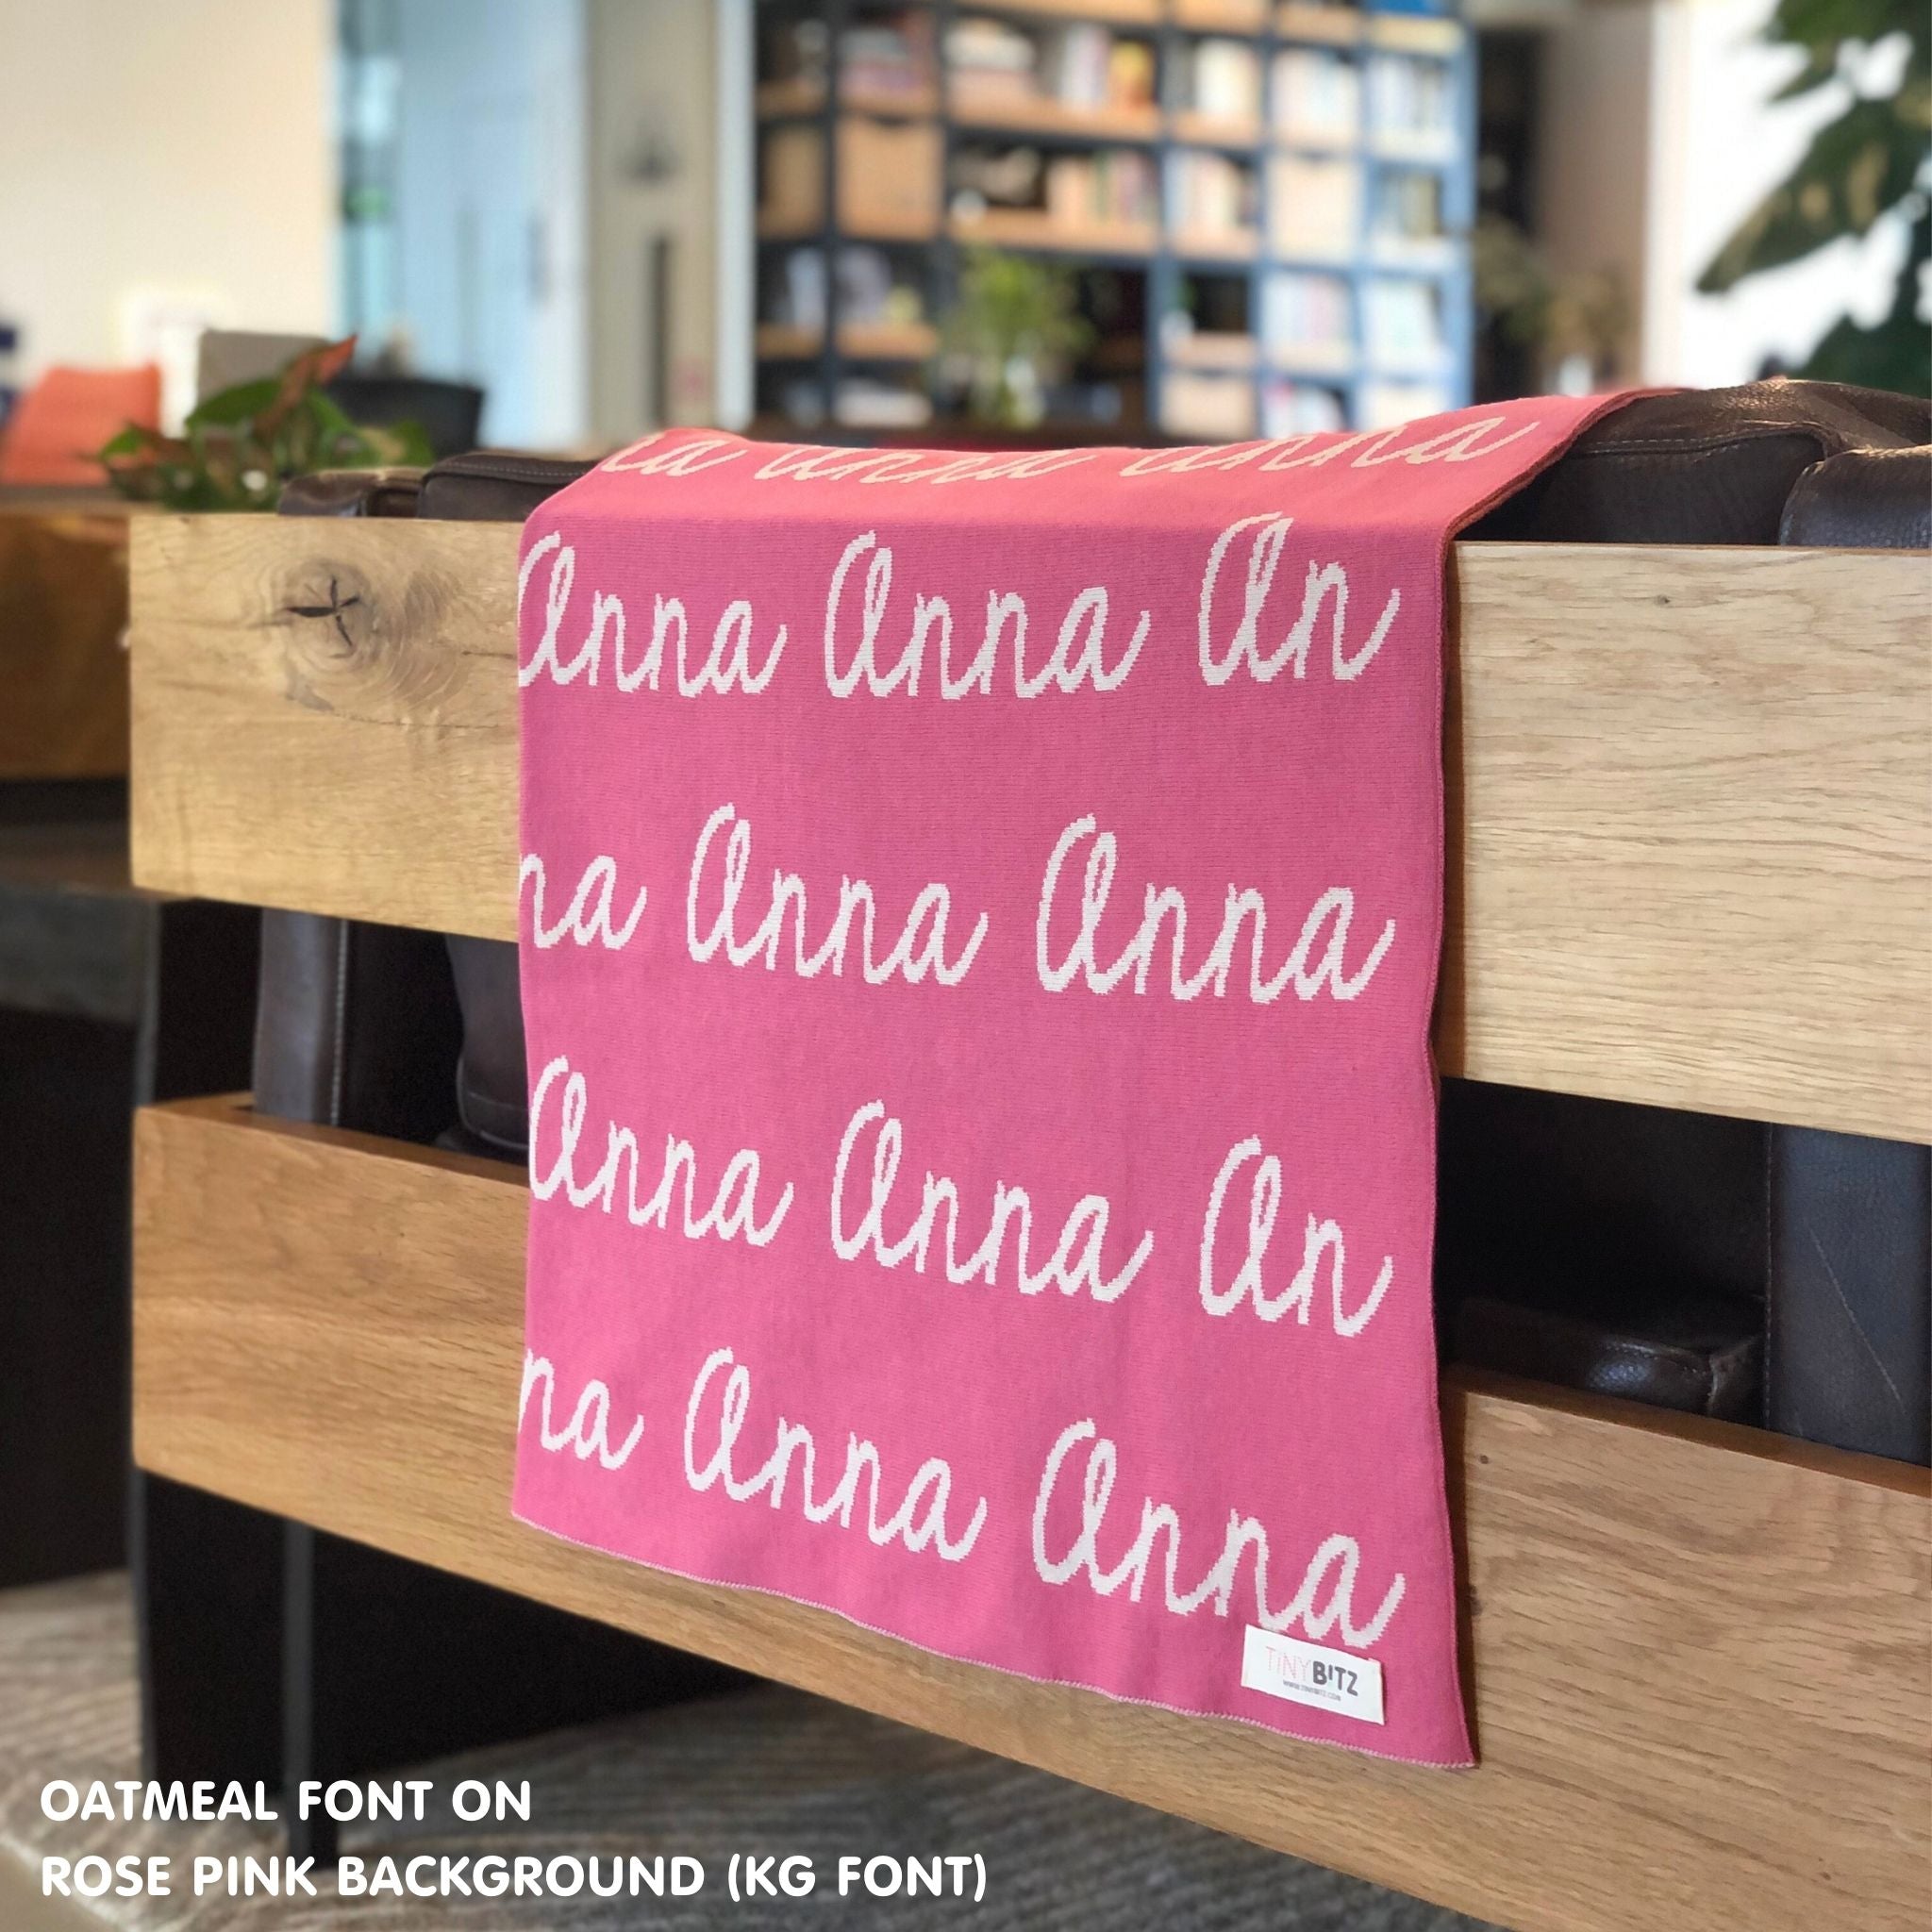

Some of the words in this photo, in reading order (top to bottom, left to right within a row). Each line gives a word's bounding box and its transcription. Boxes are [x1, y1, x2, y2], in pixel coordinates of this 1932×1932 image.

[517, 530, 788, 699] Anna
[824, 530, 1151, 700] Anna
[1198, 514, 1400, 686] An
[686, 802, 989, 986] Anna
[1036, 814, 1396, 1005] Anna
[528, 1055, 794, 1247] Anna
[830, 1099, 1154, 1303] Anna
[1198, 1136, 1393, 1338] An
[683, 1346, 988, 1562] Anna
[1032, 1418, 1406, 1648] Anna
